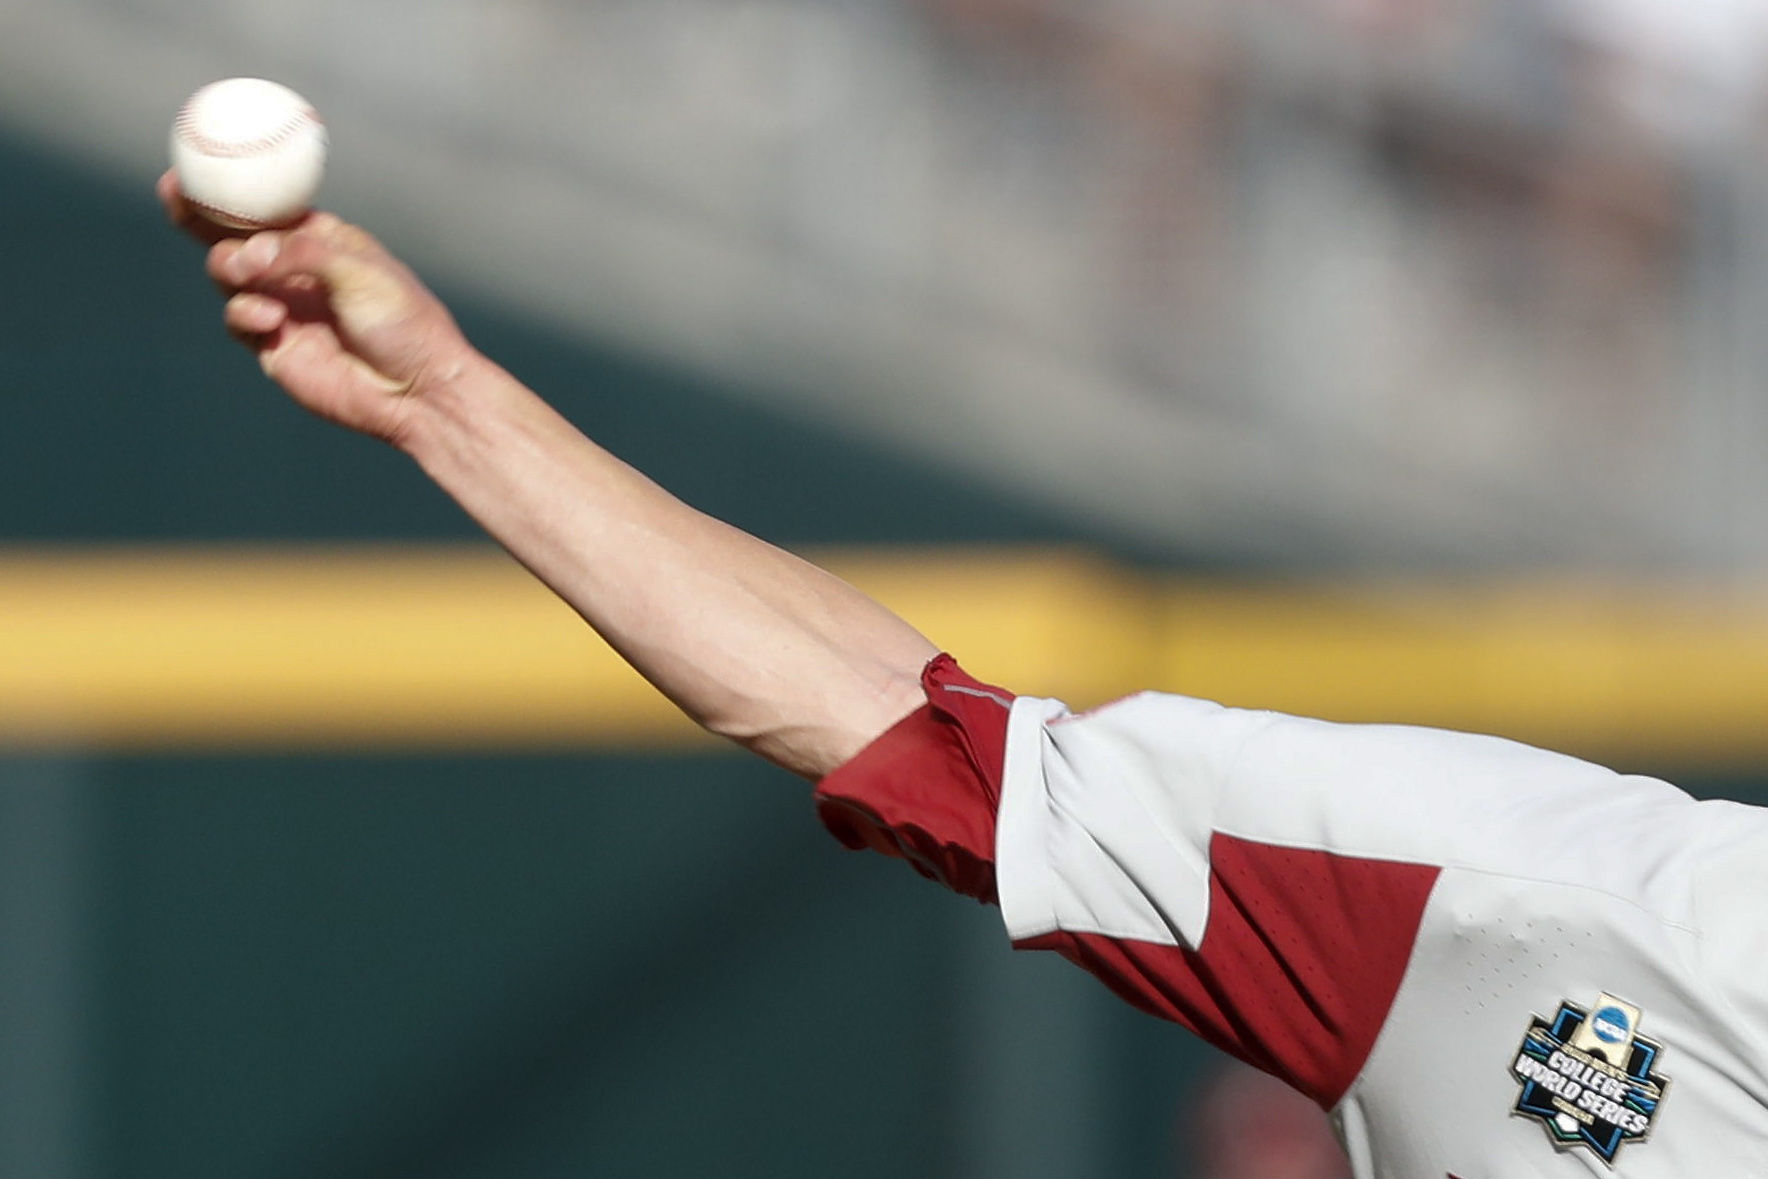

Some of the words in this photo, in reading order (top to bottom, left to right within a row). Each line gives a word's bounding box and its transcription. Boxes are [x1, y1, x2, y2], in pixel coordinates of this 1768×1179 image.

[1514, 1053, 1583, 1101] WORLD
[1577, 1089, 1649, 1133] SERIES
[1548, 1050, 1631, 1102] COLLEGE
